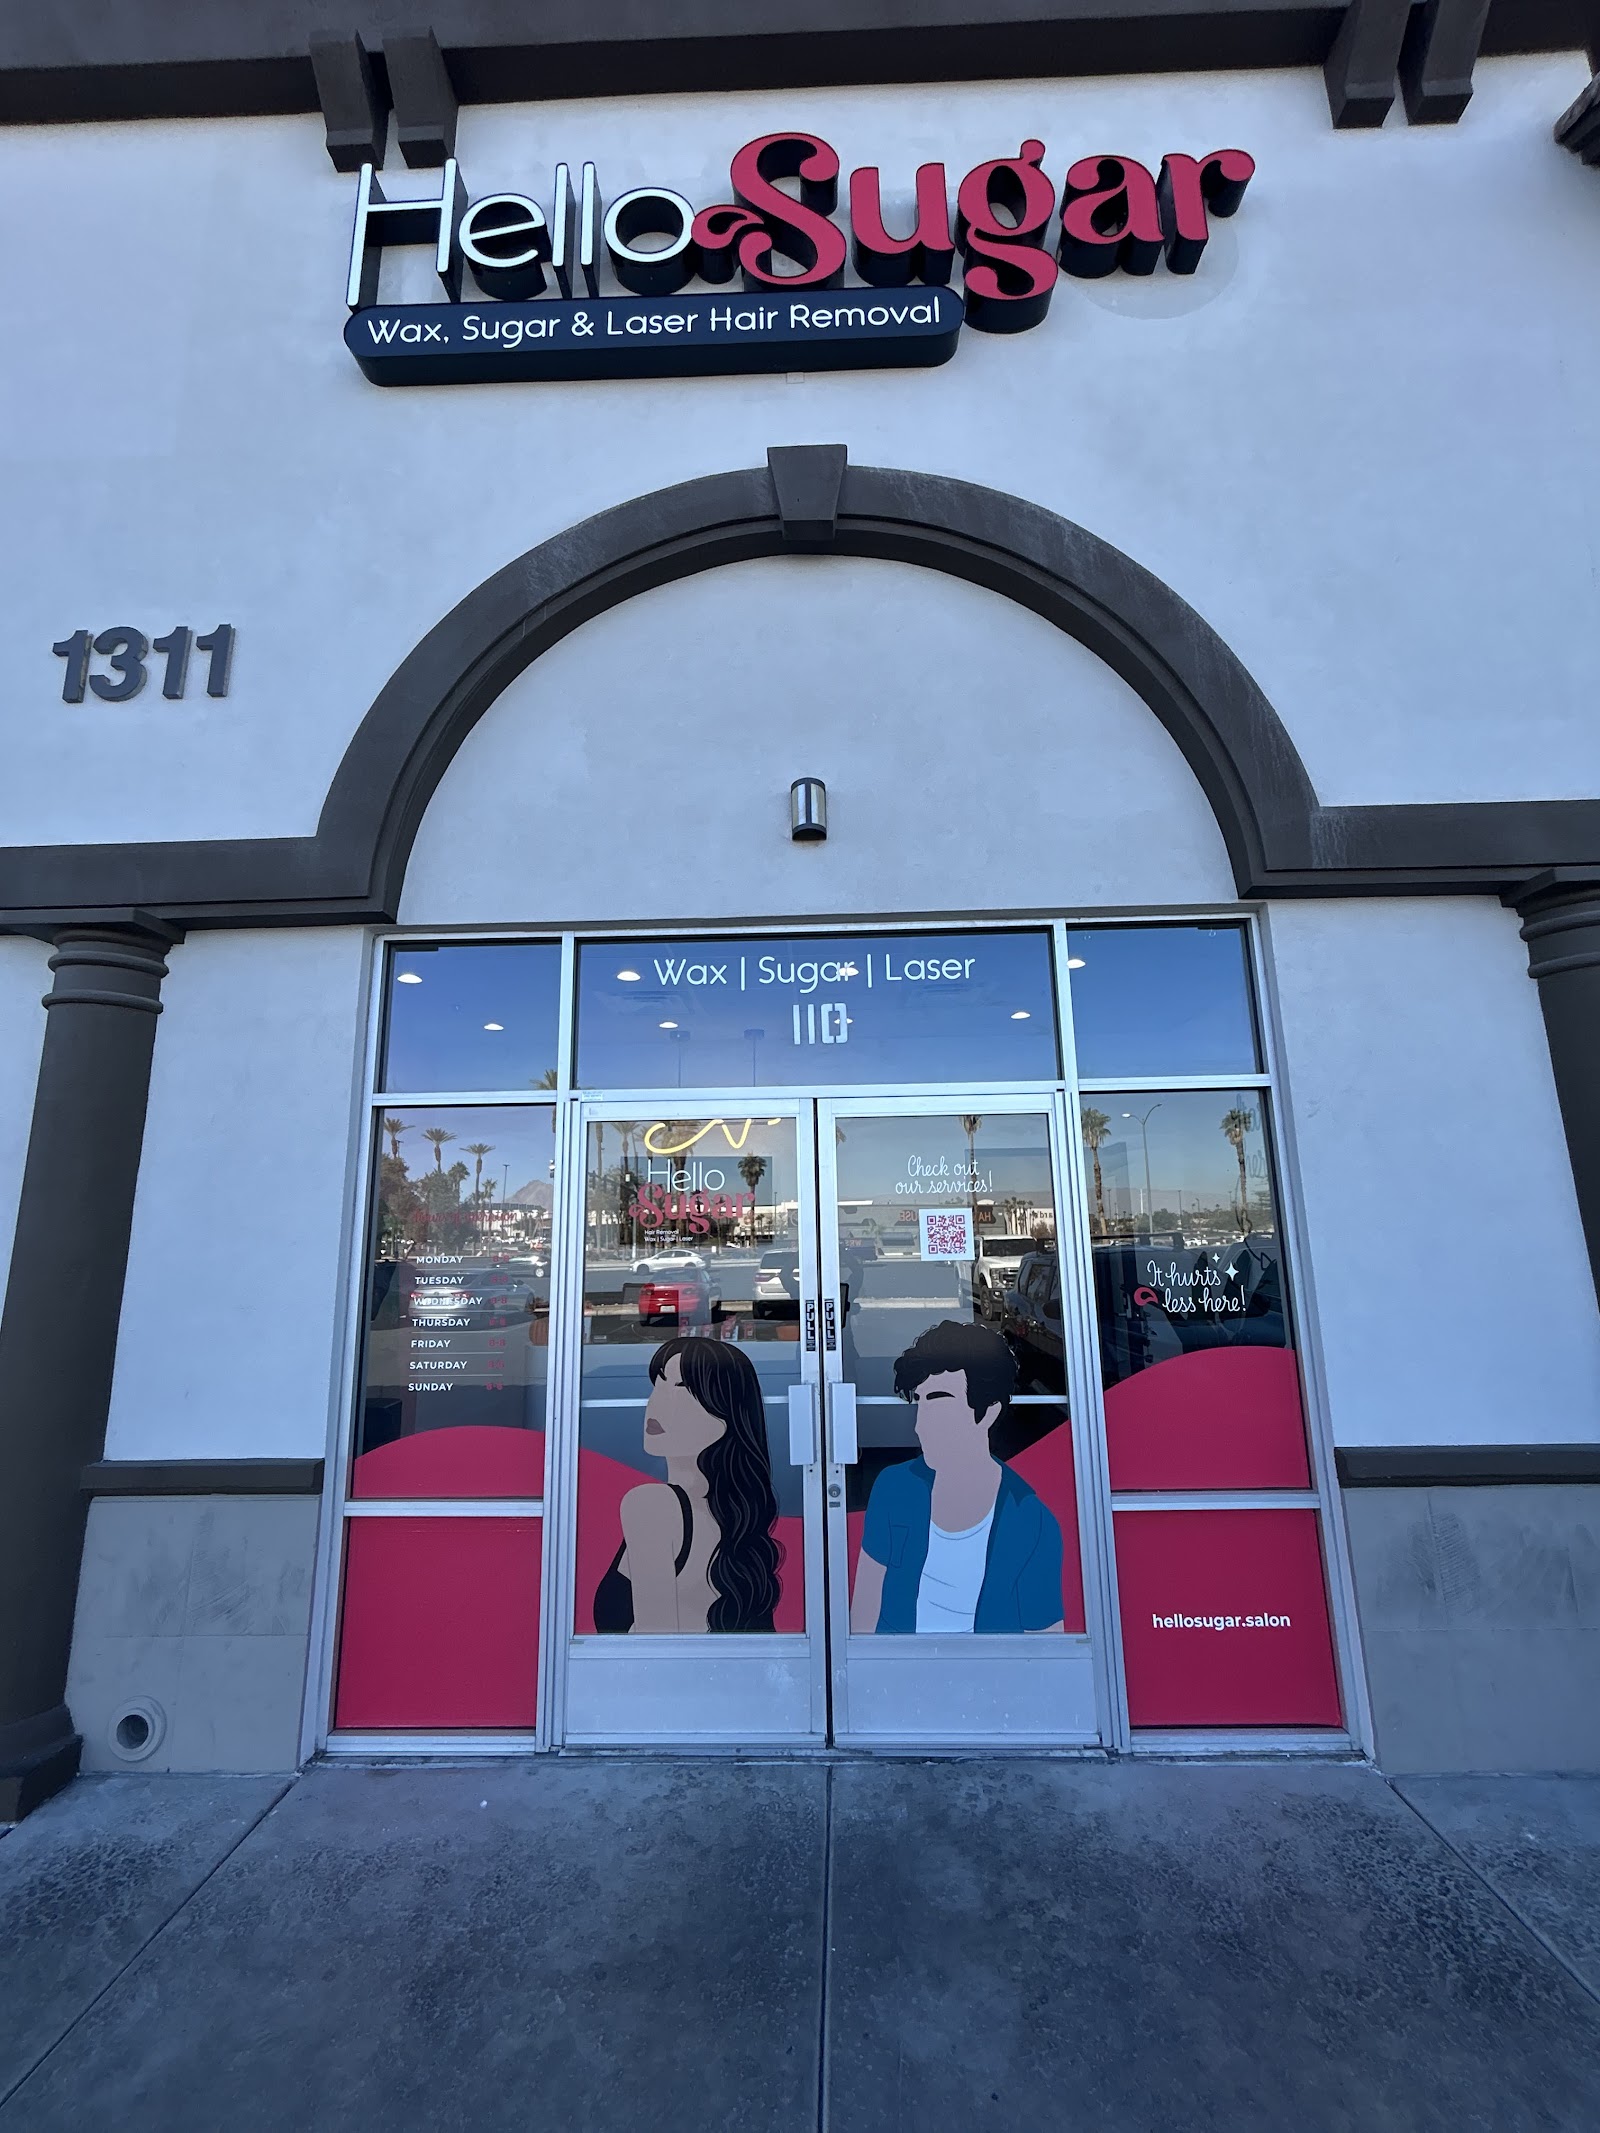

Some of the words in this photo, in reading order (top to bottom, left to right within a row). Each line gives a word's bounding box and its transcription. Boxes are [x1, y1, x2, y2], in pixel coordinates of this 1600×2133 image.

[346, 157, 694, 307] Hello
[690, 131, 1257, 303] Sugar
[366, 316, 450, 346] Wax,
[461, 314, 561, 349] Sugar
[570, 312, 596, 337] &
[606, 309, 699, 337] Laser
[709, 305, 779, 333] Hair
[789, 296, 941, 330] Removal
[52, 623, 236, 704] 1311
[653, 957, 728, 986] Wax
[757, 955, 856, 994] Sugar
[885, 953, 976, 982] Laser
[791, 1002, 849, 1045] 110
[647, 1158, 726, 1193] Hello
[907, 1154, 950, 1177] Check
[953, 1159, 980, 1176] out
[895, 1181, 924, 1194] our
[926, 1170, 993, 1194] services!
[628, 1183, 756, 1234] Sugar
[416, 1255, 464, 1264] MONDAY
[1146, 1259, 1165, 1287] It
[1165, 1261, 1221, 1287] hurts
[414, 1276, 465, 1285] TUESDAY
[413, 1297, 483, 1306] WEDNESDAY
[1161, 1287, 1197, 1313] less
[1197, 1284, 1247, 1312] here!
[412, 1318, 471, 1327] THURSDAY
[806, 1303, 815, 1340] PULL
[825, 1302, 835, 1339] PULL
[410, 1339, 451, 1348] FRIDAY
[409, 1361, 468, 1370] SATURDAY
[408, 1382, 454, 1392] SUNDAY
[1152, 1612, 1291, 1631] hellosugar.salon
